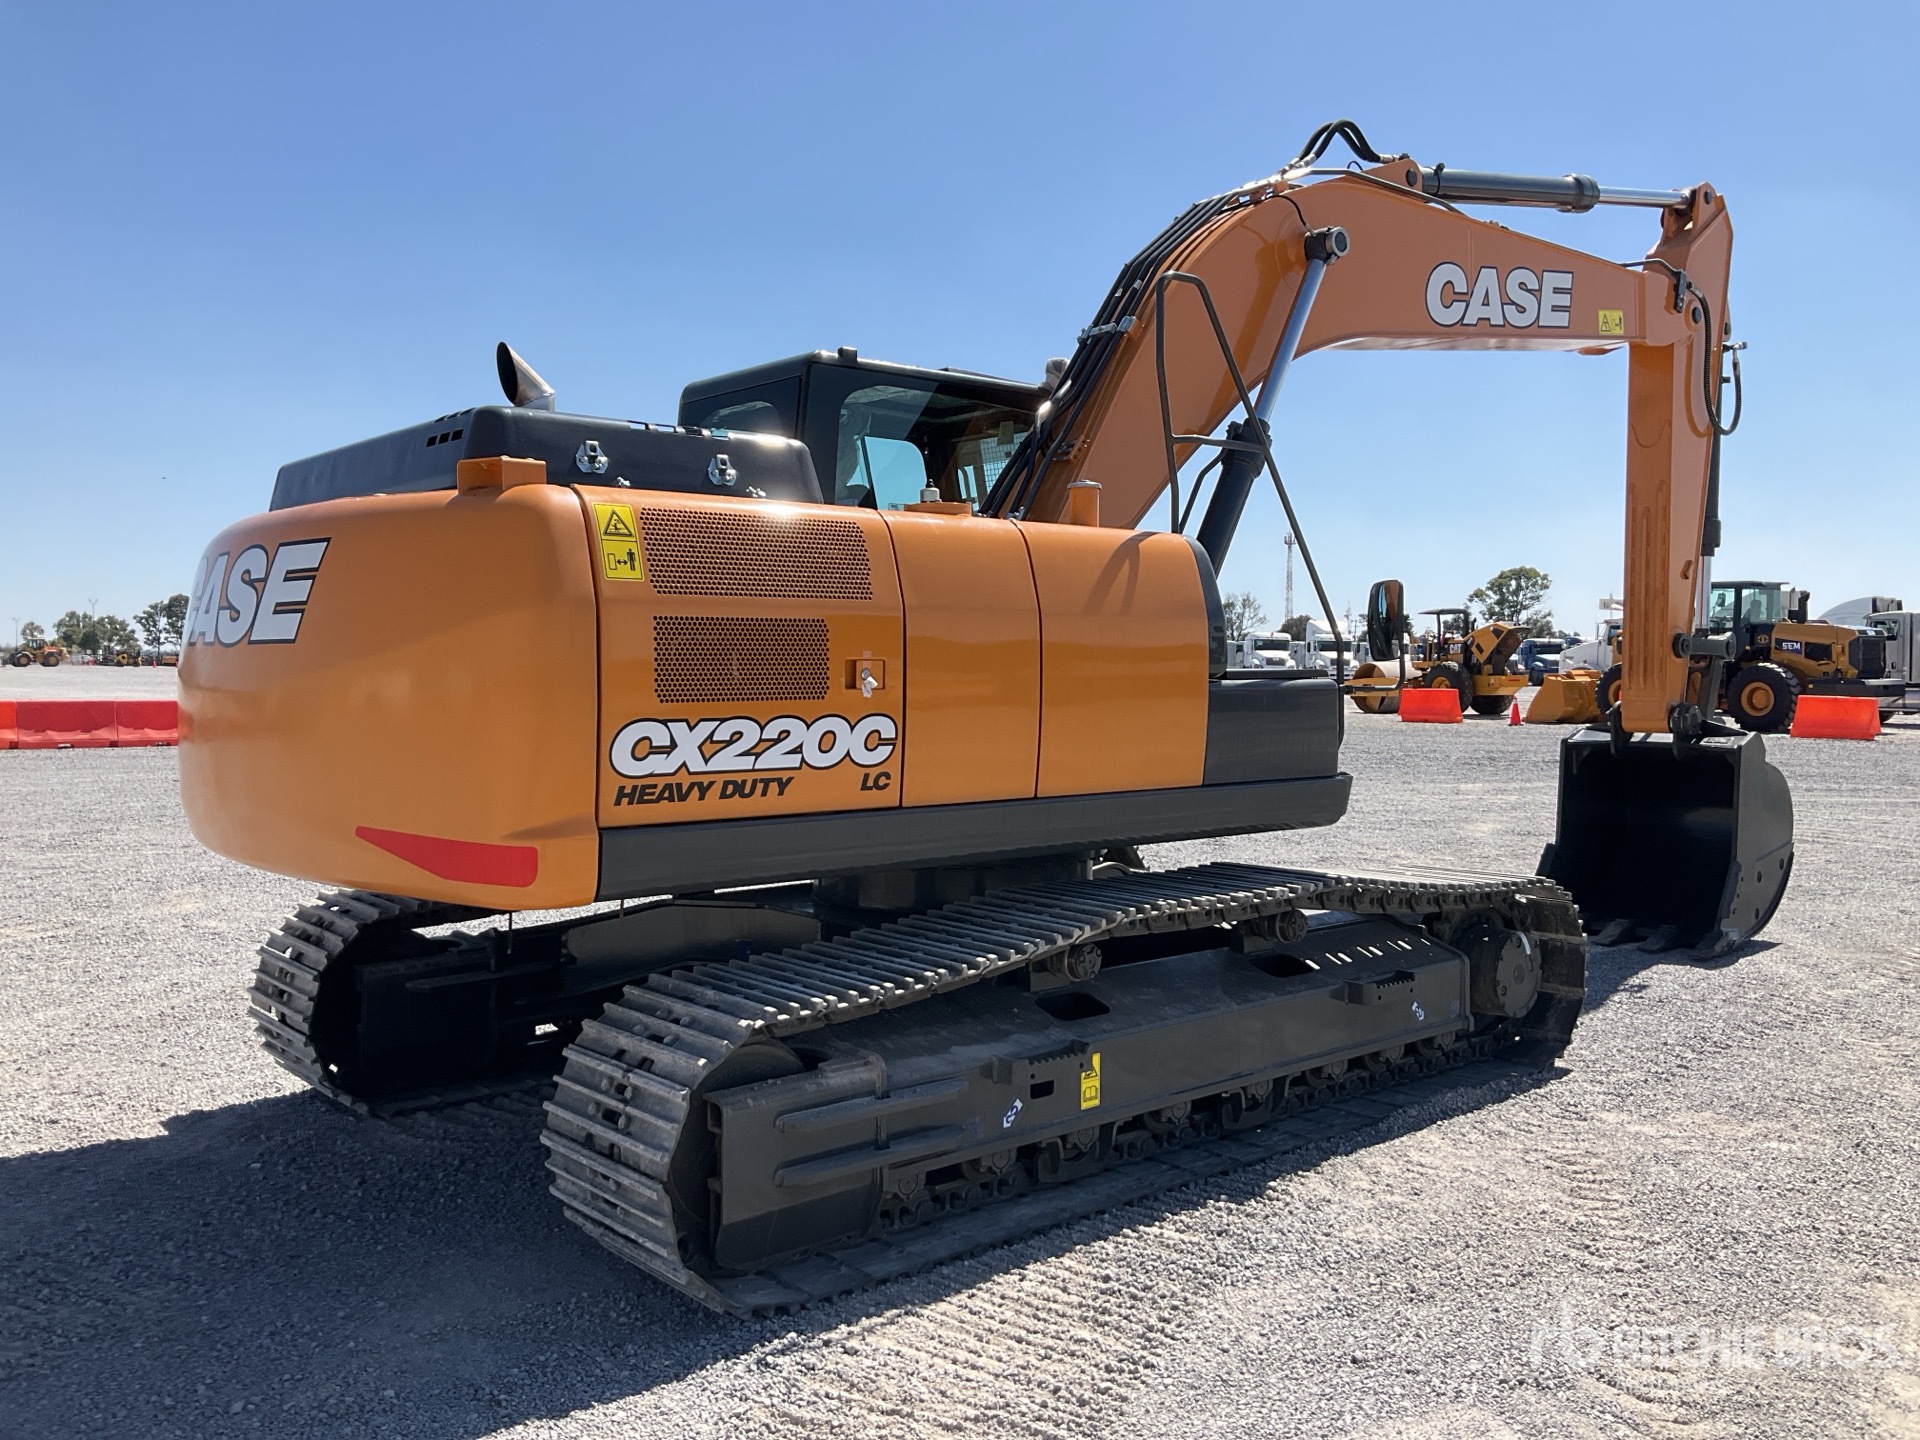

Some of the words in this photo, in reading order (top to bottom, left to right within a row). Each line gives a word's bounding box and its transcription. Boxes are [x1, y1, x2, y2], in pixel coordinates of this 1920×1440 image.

[1425, 261, 1574, 329] CASE
[1449, 644, 1462, 654] CAT
[1782, 642, 1801, 650] SEM
[609, 712, 899, 779] CX220C
[613, 780, 721, 806] HEAVY
[719, 776, 795, 800] DUTY
[860, 771, 892, 792] LC
